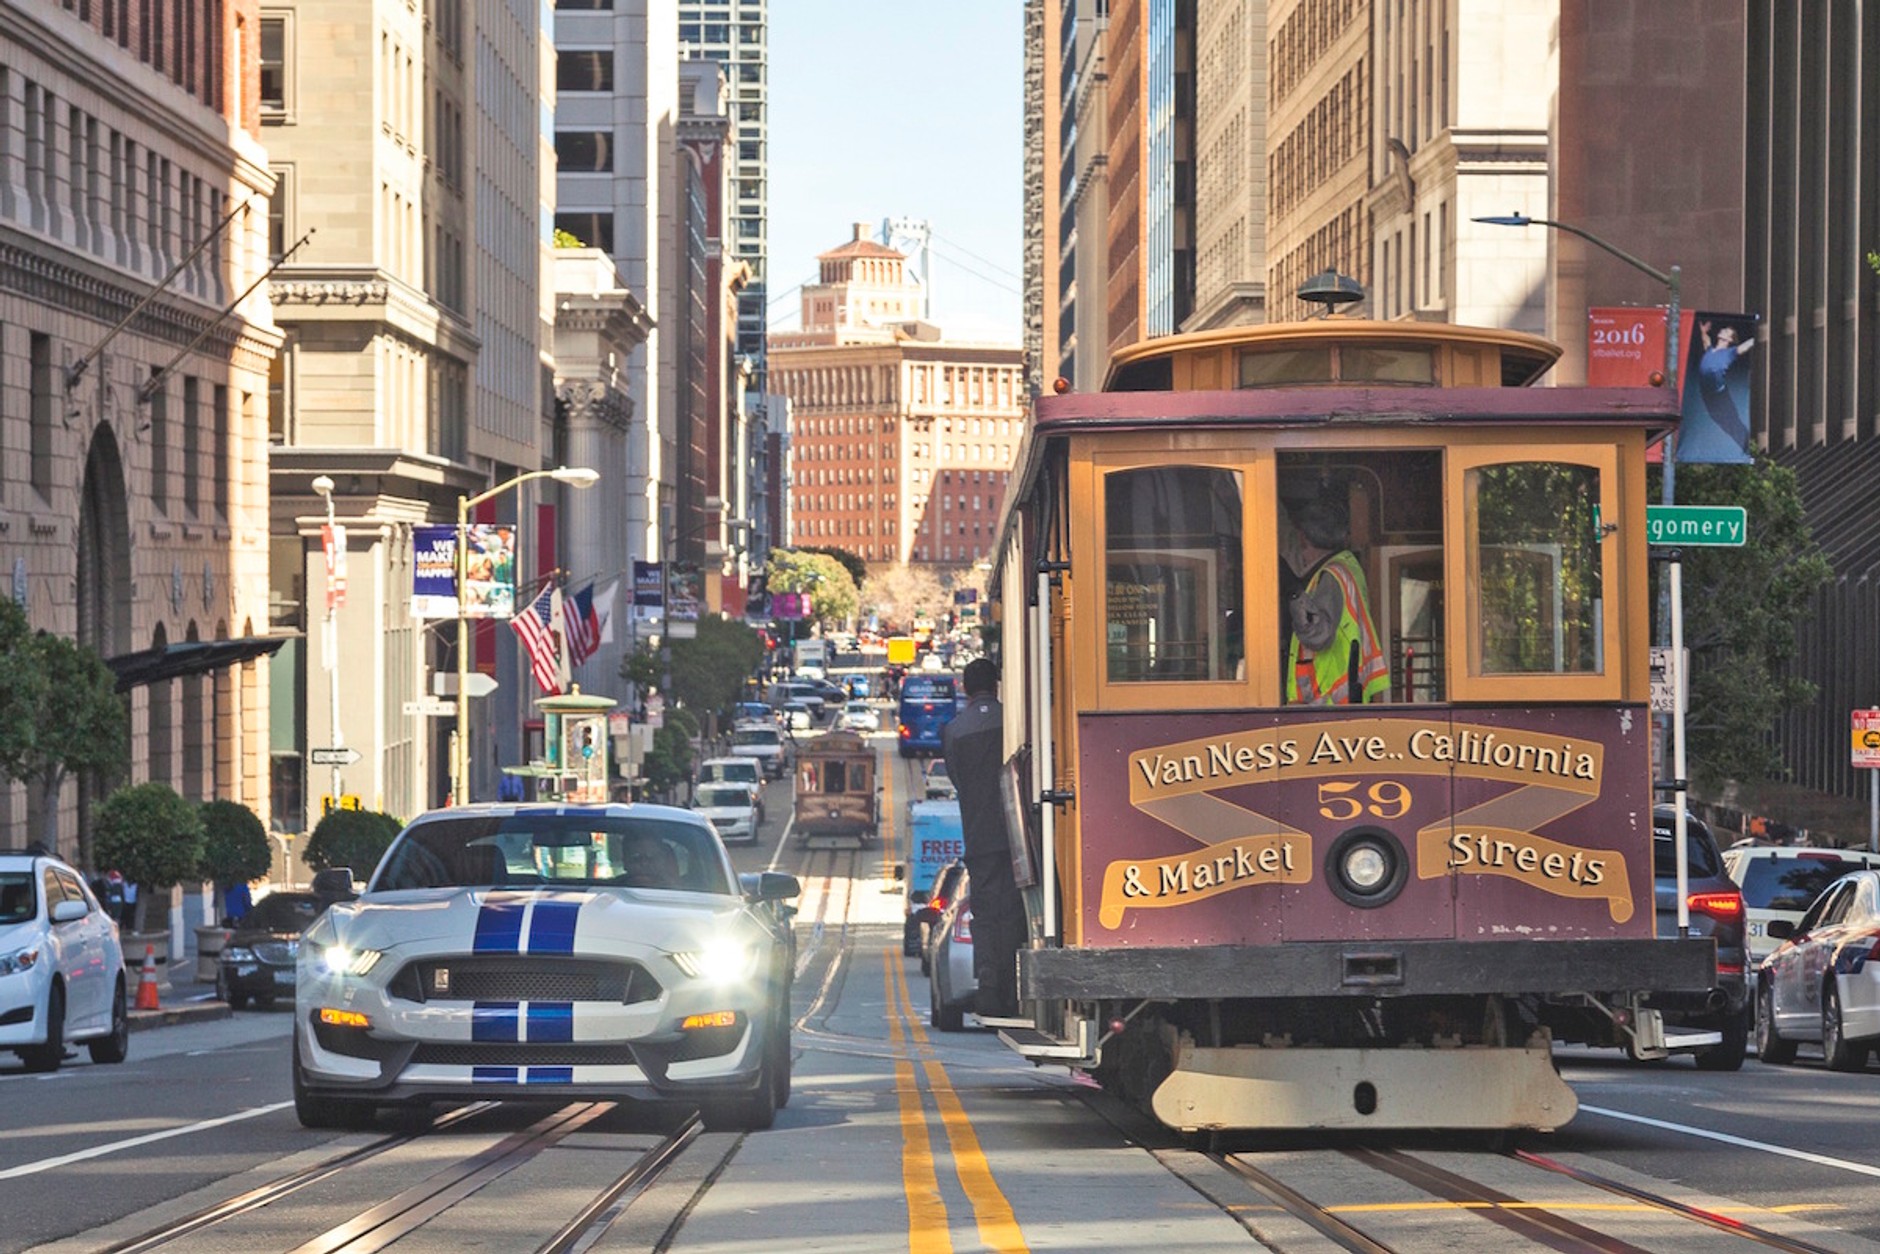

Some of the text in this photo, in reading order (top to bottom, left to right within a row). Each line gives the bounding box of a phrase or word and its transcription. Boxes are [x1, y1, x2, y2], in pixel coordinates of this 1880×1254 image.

[1593, 323, 1645, 345] 2016
[416, 551, 456, 563] MAKE
[432, 540, 456, 553] WE
[1139, 753, 1204, 788] Van
[1206, 740, 1300, 778] Ness
[1409, 728, 1595, 780] California
[1318, 781, 1413, 820] 59
[921, 839, 962, 855] FREE
[1123, 841, 1296, 898] & Market
[1449, 833, 1607, 885] Streets
[1749, 921, 1763, 937] 31
